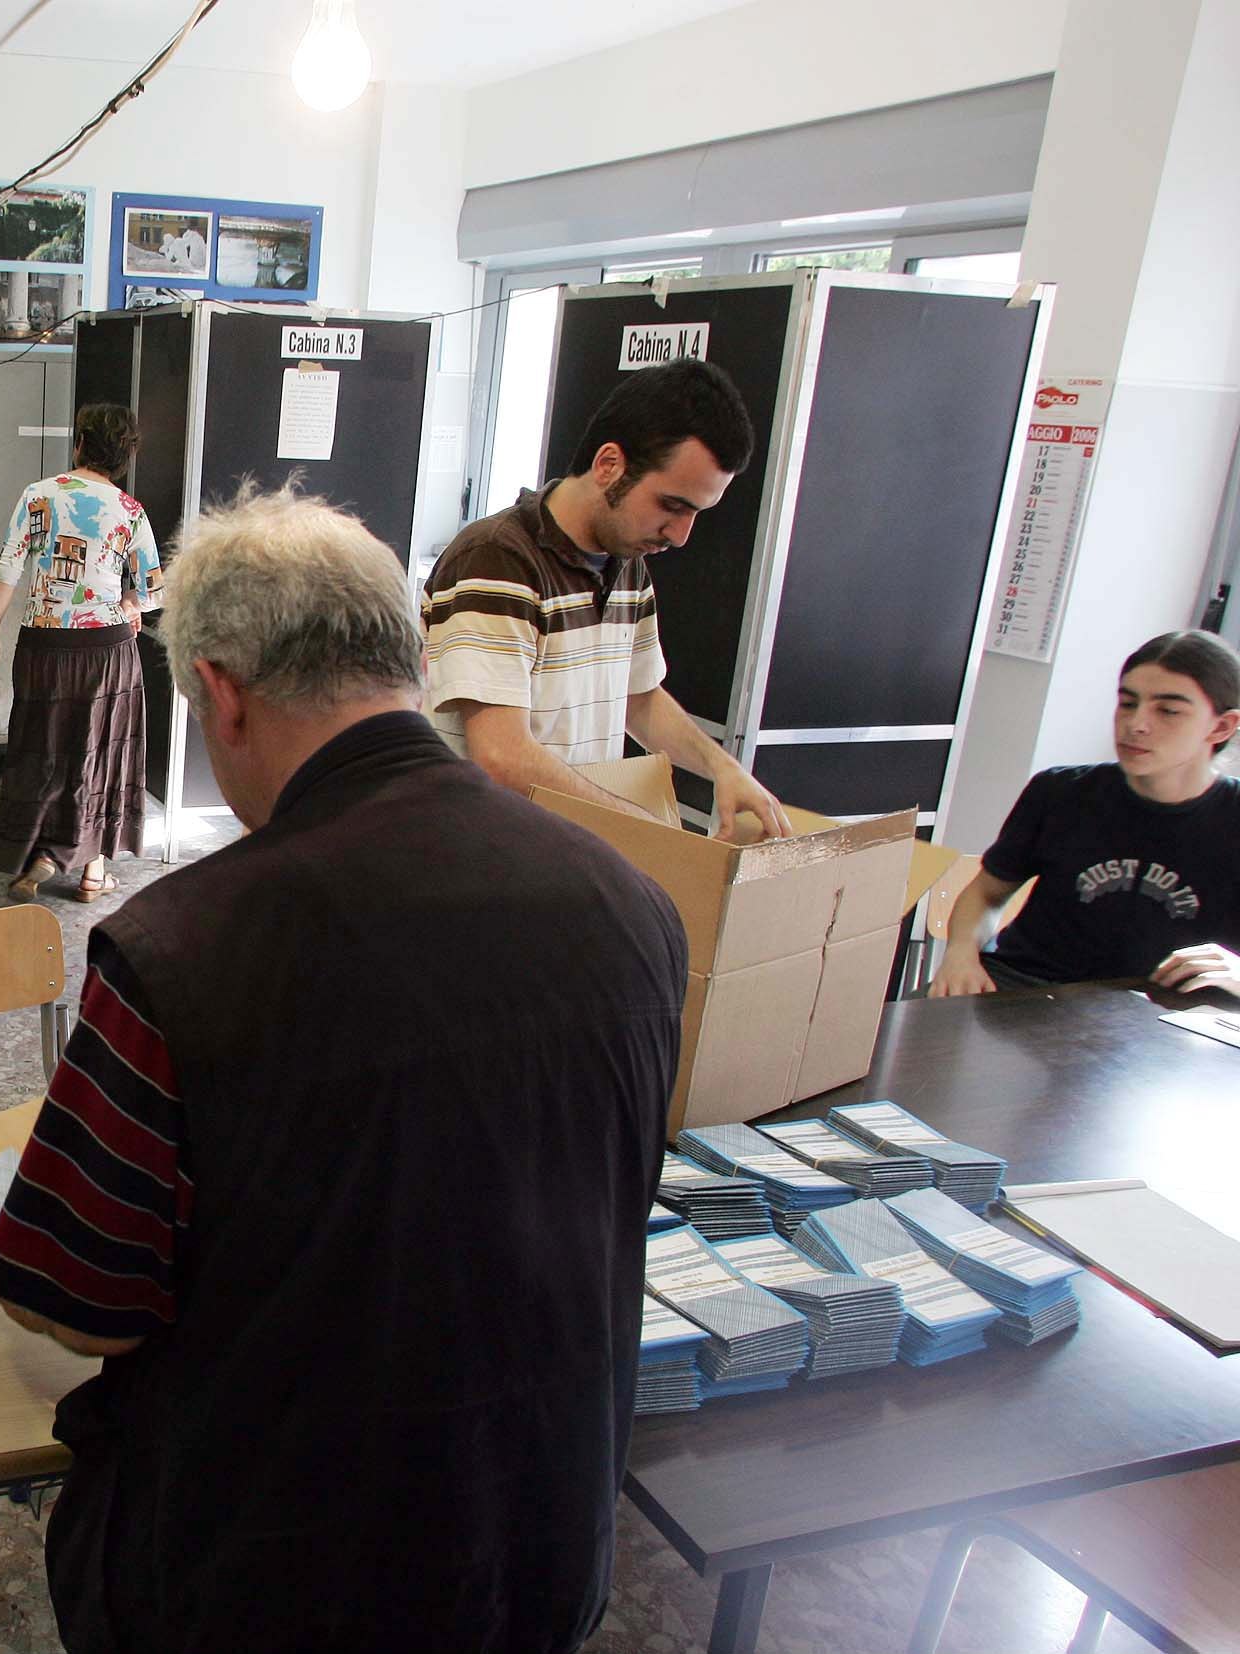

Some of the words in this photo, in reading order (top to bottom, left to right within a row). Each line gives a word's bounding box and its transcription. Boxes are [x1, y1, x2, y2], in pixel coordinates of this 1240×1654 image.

[289, 331, 330, 354] Cabina
[336, 333, 356, 355] N.3
[628, 331, 672, 362] Cabina
[677, 330, 701, 360] N.4
[1036, 393, 1077, 405] PAOLO
[1028, 425, 1063, 441] AGGIO
[1039, 446, 1050, 456] 17
[1036, 459, 1047, 469] 18
[1033, 472, 1044, 482] 19
[1030, 485, 1042, 495] 20
[1026, 497, 1038, 508] 21
[1024, 510, 1036, 521] 22
[1020, 523, 1032, 534] 23
[1017, 536, 1030, 546] 24
[1015, 549, 1027, 560] 25
[1012, 561, 1024, 572] 26
[1009, 574, 1021, 584] 27
[1003, 599, 1015, 610] 29
[1000, 611, 1013, 621] 30
[996, 623, 1008, 634] 31
[1077, 858, 1139, 891] JUST
[1143, 862, 1179, 890] DO
